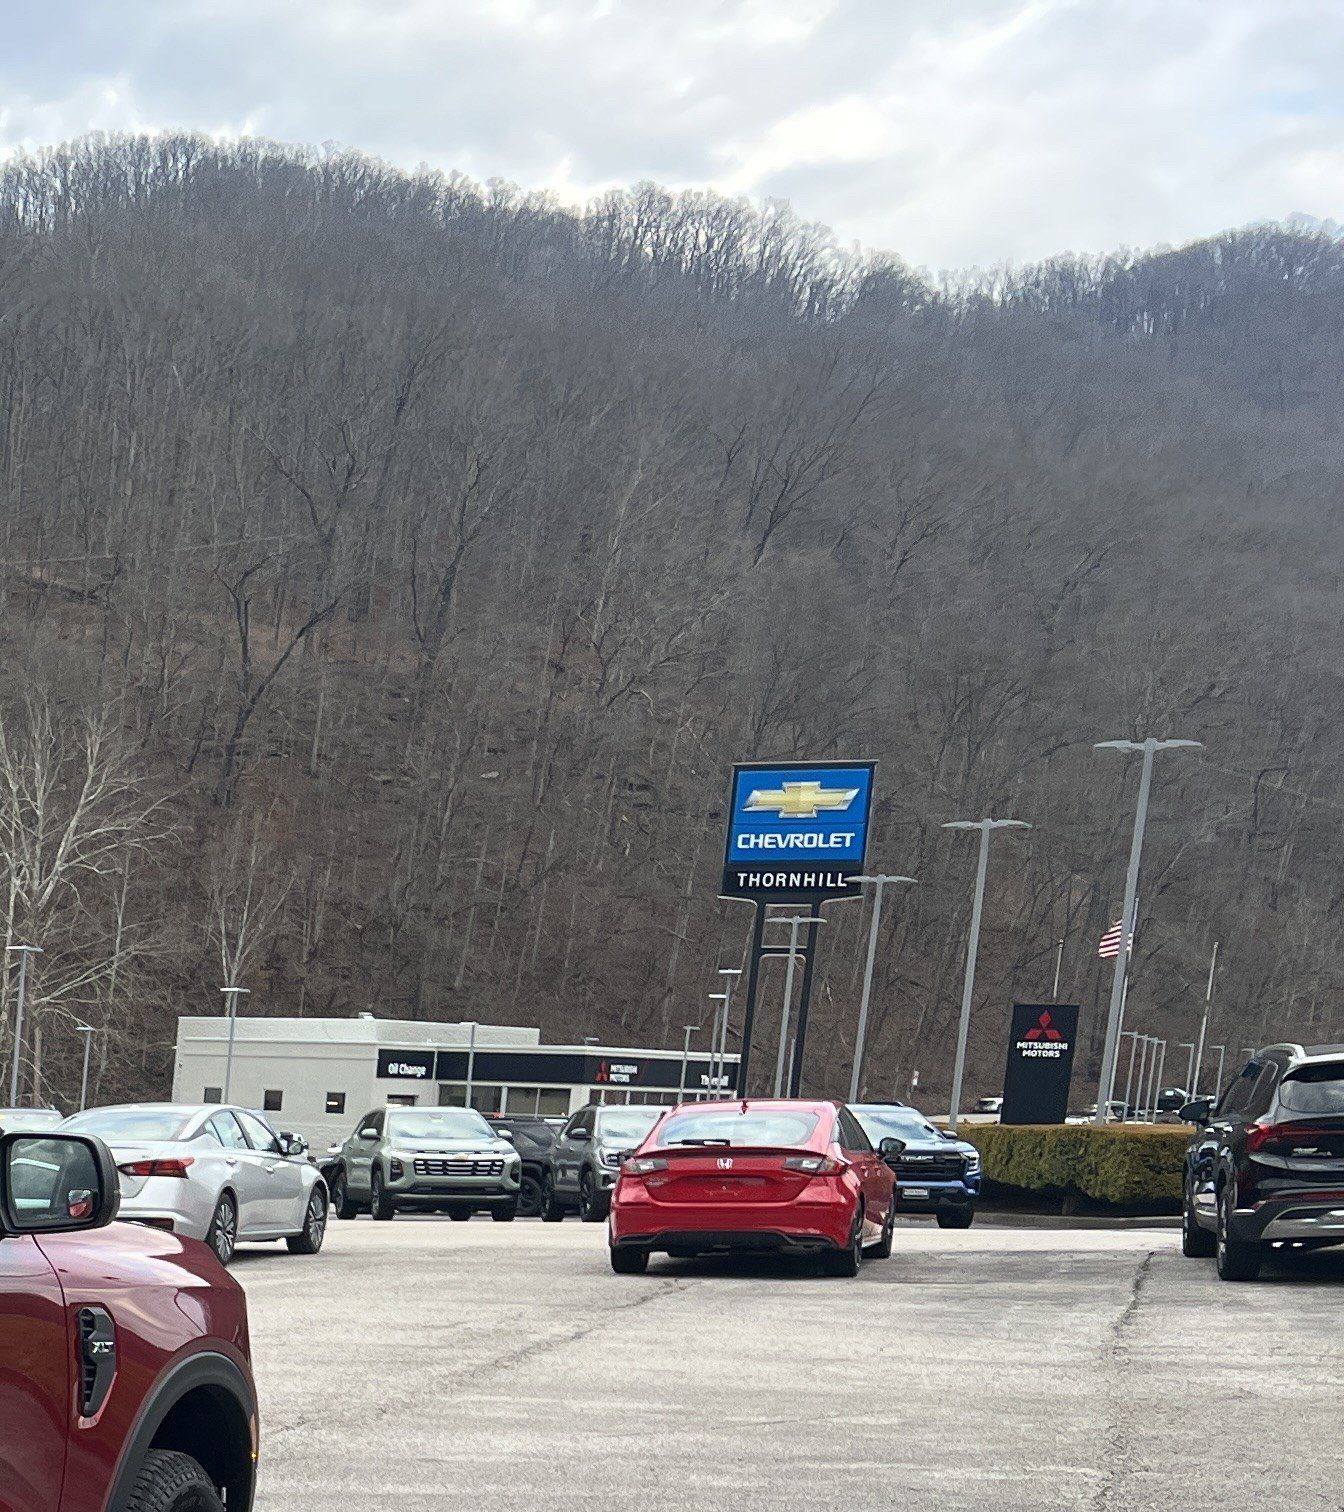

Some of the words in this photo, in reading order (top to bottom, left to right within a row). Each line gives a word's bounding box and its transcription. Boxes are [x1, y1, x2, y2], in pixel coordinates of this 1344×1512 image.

[737, 832, 856, 849] CHEVROLET
[737, 872, 848, 887] THORNHILL
[1016, 1041, 1068, 1050] MITSUBISHI
[1022, 1050, 1061, 1058] MOTORS
[92, 1341, 114, 1353] XLT
